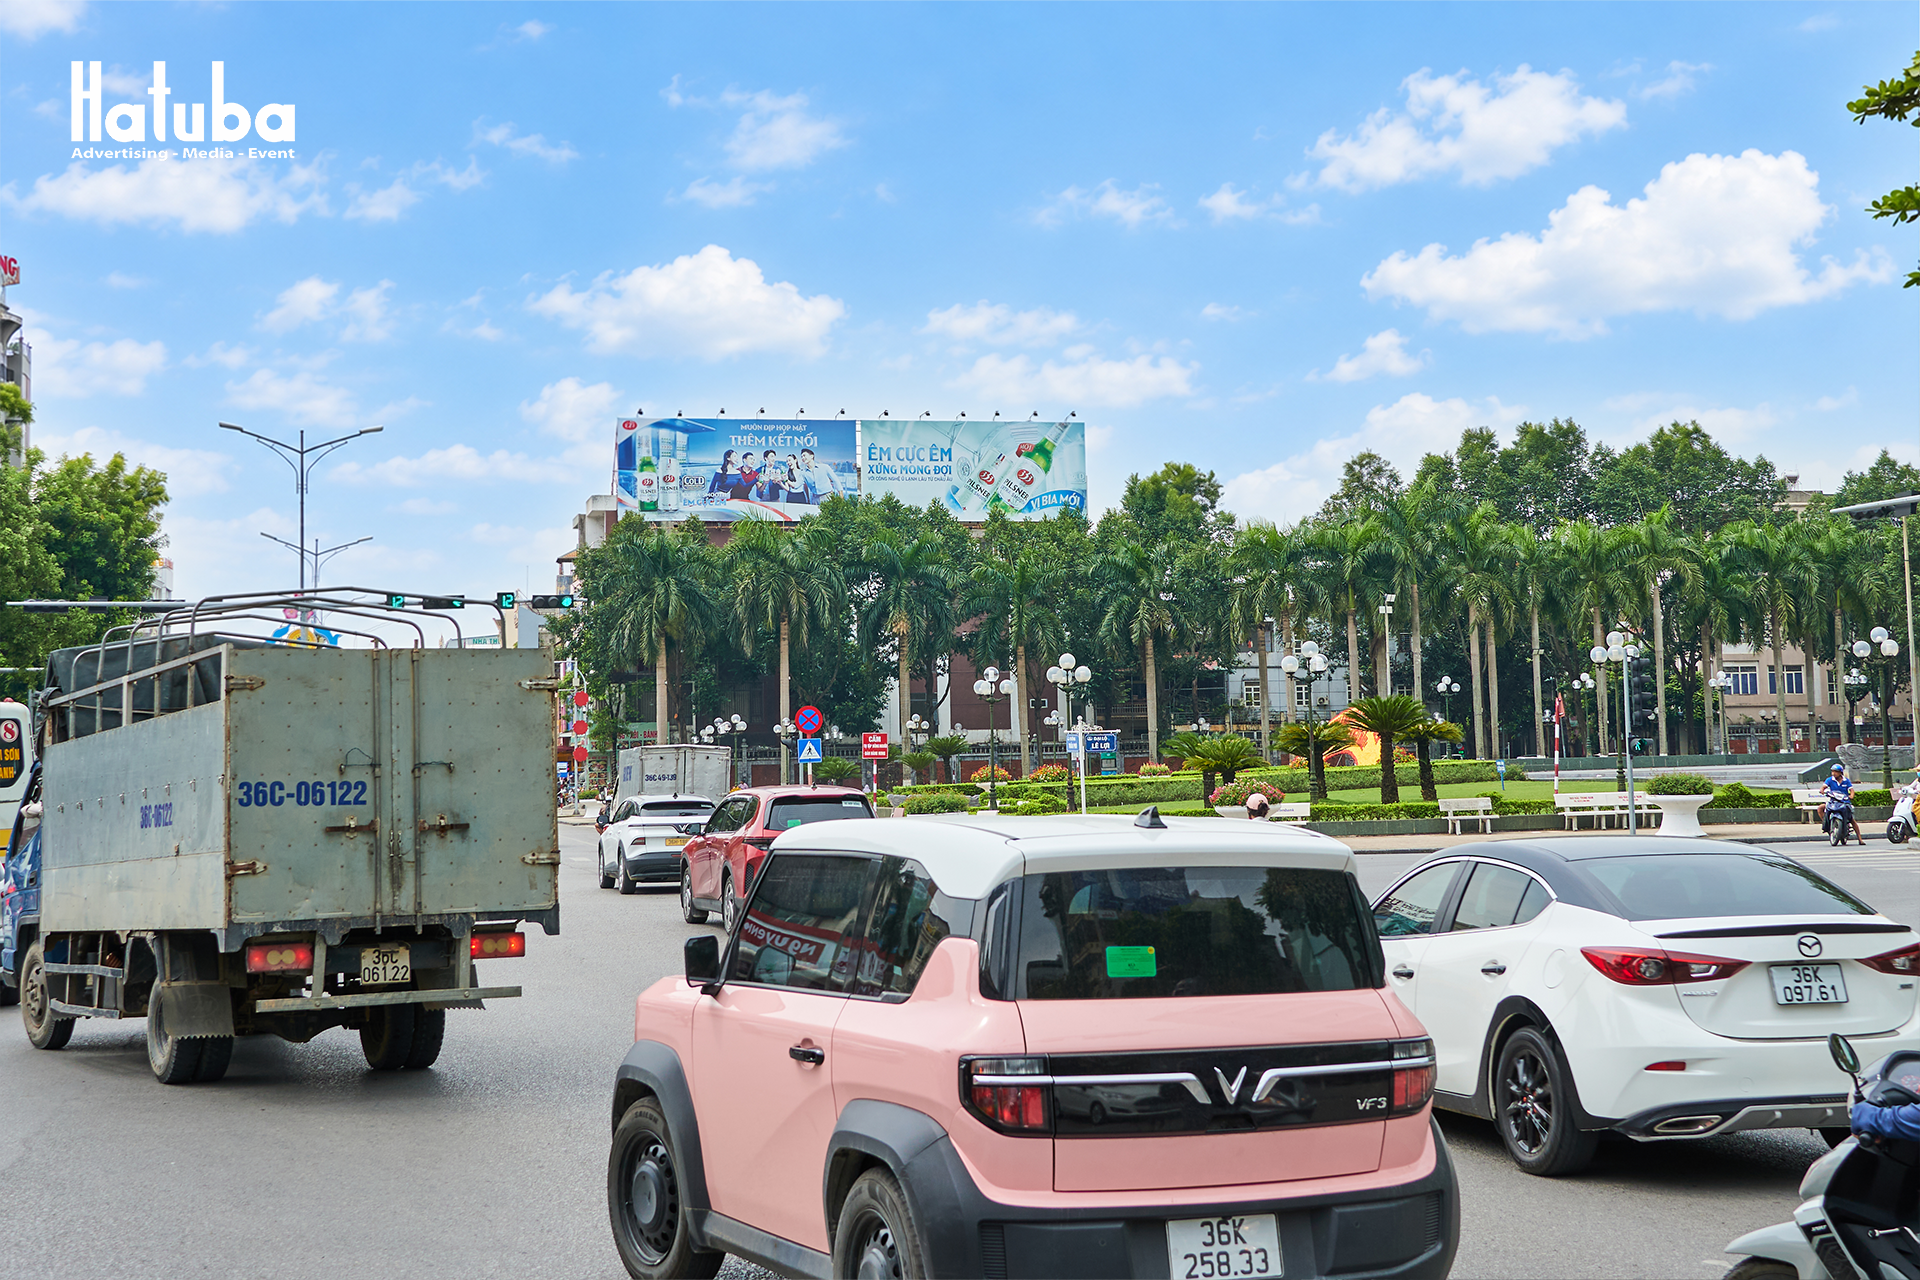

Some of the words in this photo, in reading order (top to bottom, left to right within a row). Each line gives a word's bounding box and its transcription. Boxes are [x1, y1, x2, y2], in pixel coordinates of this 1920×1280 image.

[729, 433, 766, 446] THÊM
[769, 432, 792, 446] KẾT
[794, 432, 818, 447] NỐI
[868, 443, 891, 461] ÊM
[896, 445, 925, 463] CỰC
[929, 444, 952, 461] ÊM
[868, 463, 897, 474] XỨNG
[900, 465, 931, 474] MONG
[933, 465, 952, 476] ĐỢI
[1042, 494, 1058, 506] BIA
[502, 594, 513, 607] 12
[4, 723, 15, 739] 8
[4, 747, 20, 761] SƠN
[238, 780, 367, 807] 36C-06122
[140, 802, 173, 829] 36C-06122
[363, 965, 409, 982] 061.22
[1791, 967, 1823, 983] 36K
[1783, 985, 1838, 1002] 097.61
[1356, 1097, 1387, 1110] VF3
[1200, 1218, 1247, 1247] 36K
[1184, 1248, 1269, 1279] 258.33
